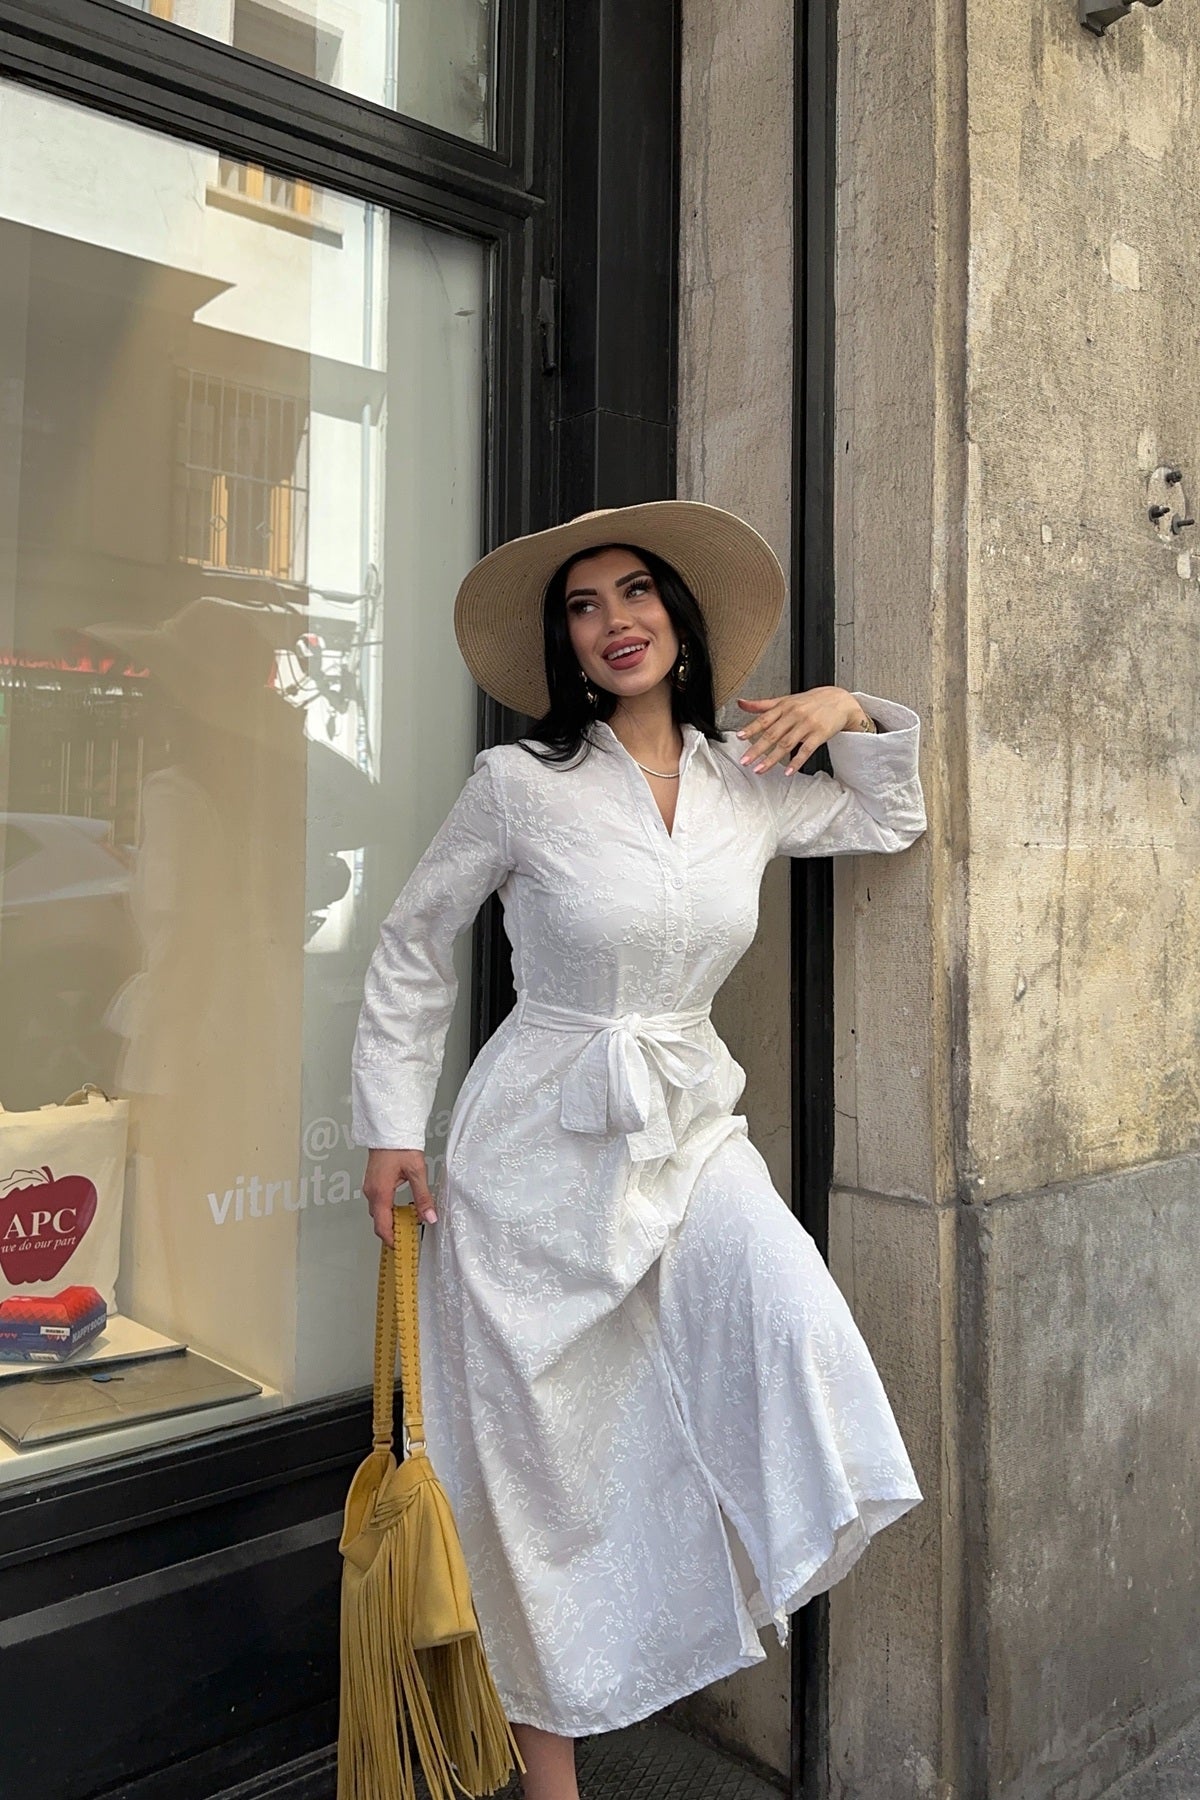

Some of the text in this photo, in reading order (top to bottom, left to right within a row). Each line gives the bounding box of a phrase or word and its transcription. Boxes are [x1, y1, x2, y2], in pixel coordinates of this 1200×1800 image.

[3, 1208, 77, 1240] APC
[1, 1236, 77, 1254] we do our part
